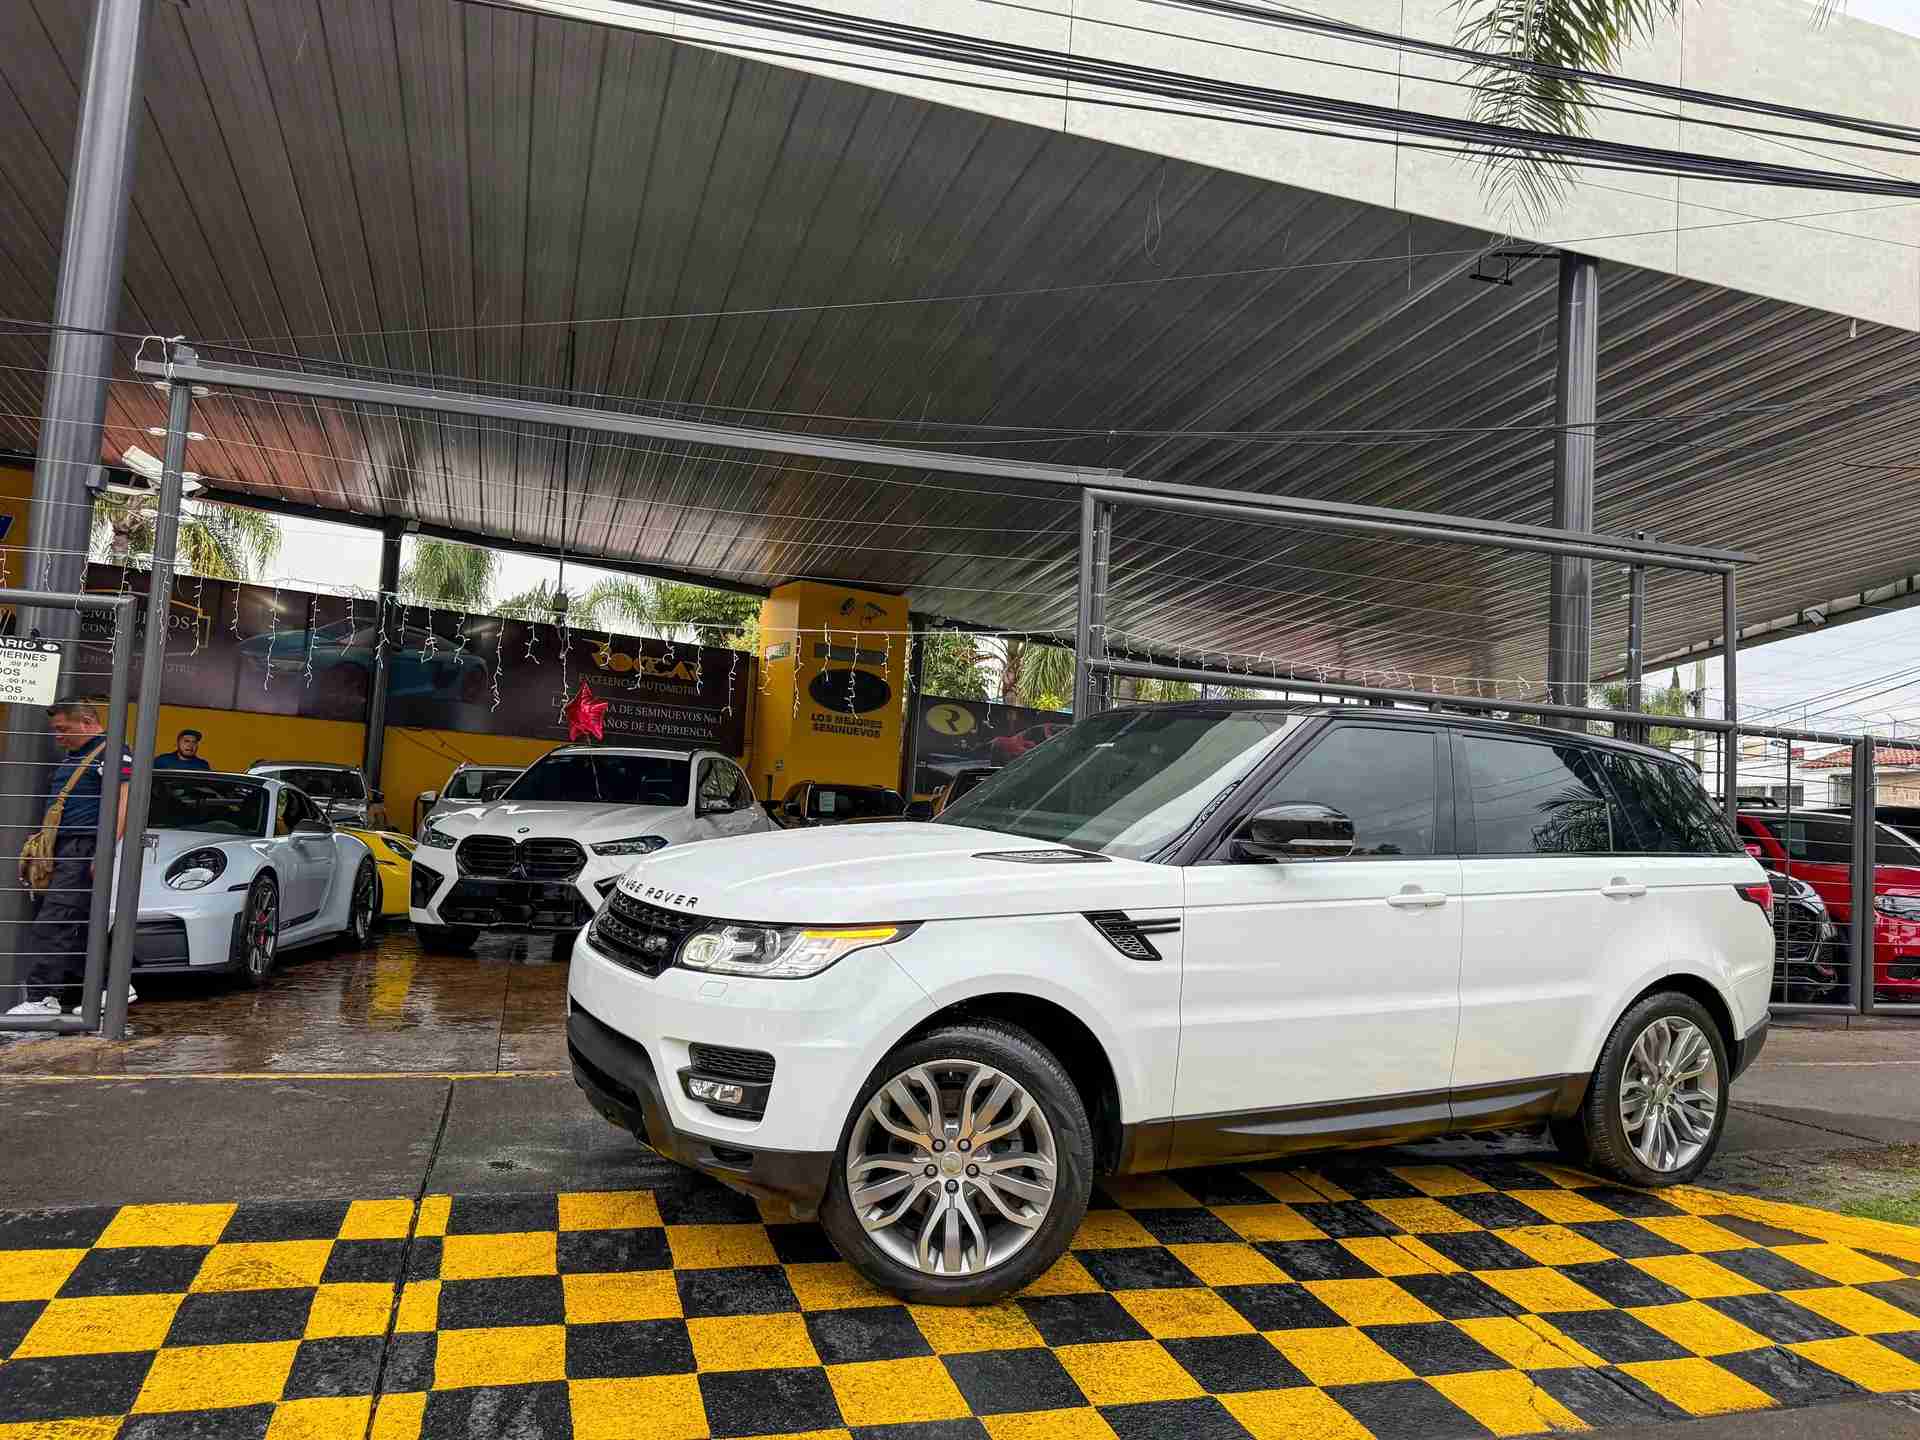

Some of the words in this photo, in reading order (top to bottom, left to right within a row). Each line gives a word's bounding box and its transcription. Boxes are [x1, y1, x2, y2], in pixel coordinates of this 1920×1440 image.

[618, 703, 634, 715] DE
[635, 706, 704, 722] SEMINUEVOS
[631, 719, 646, 731] DE
[647, 721, 713, 738] EXPERIENCIA
[645, 887, 698, 908] ROVER
